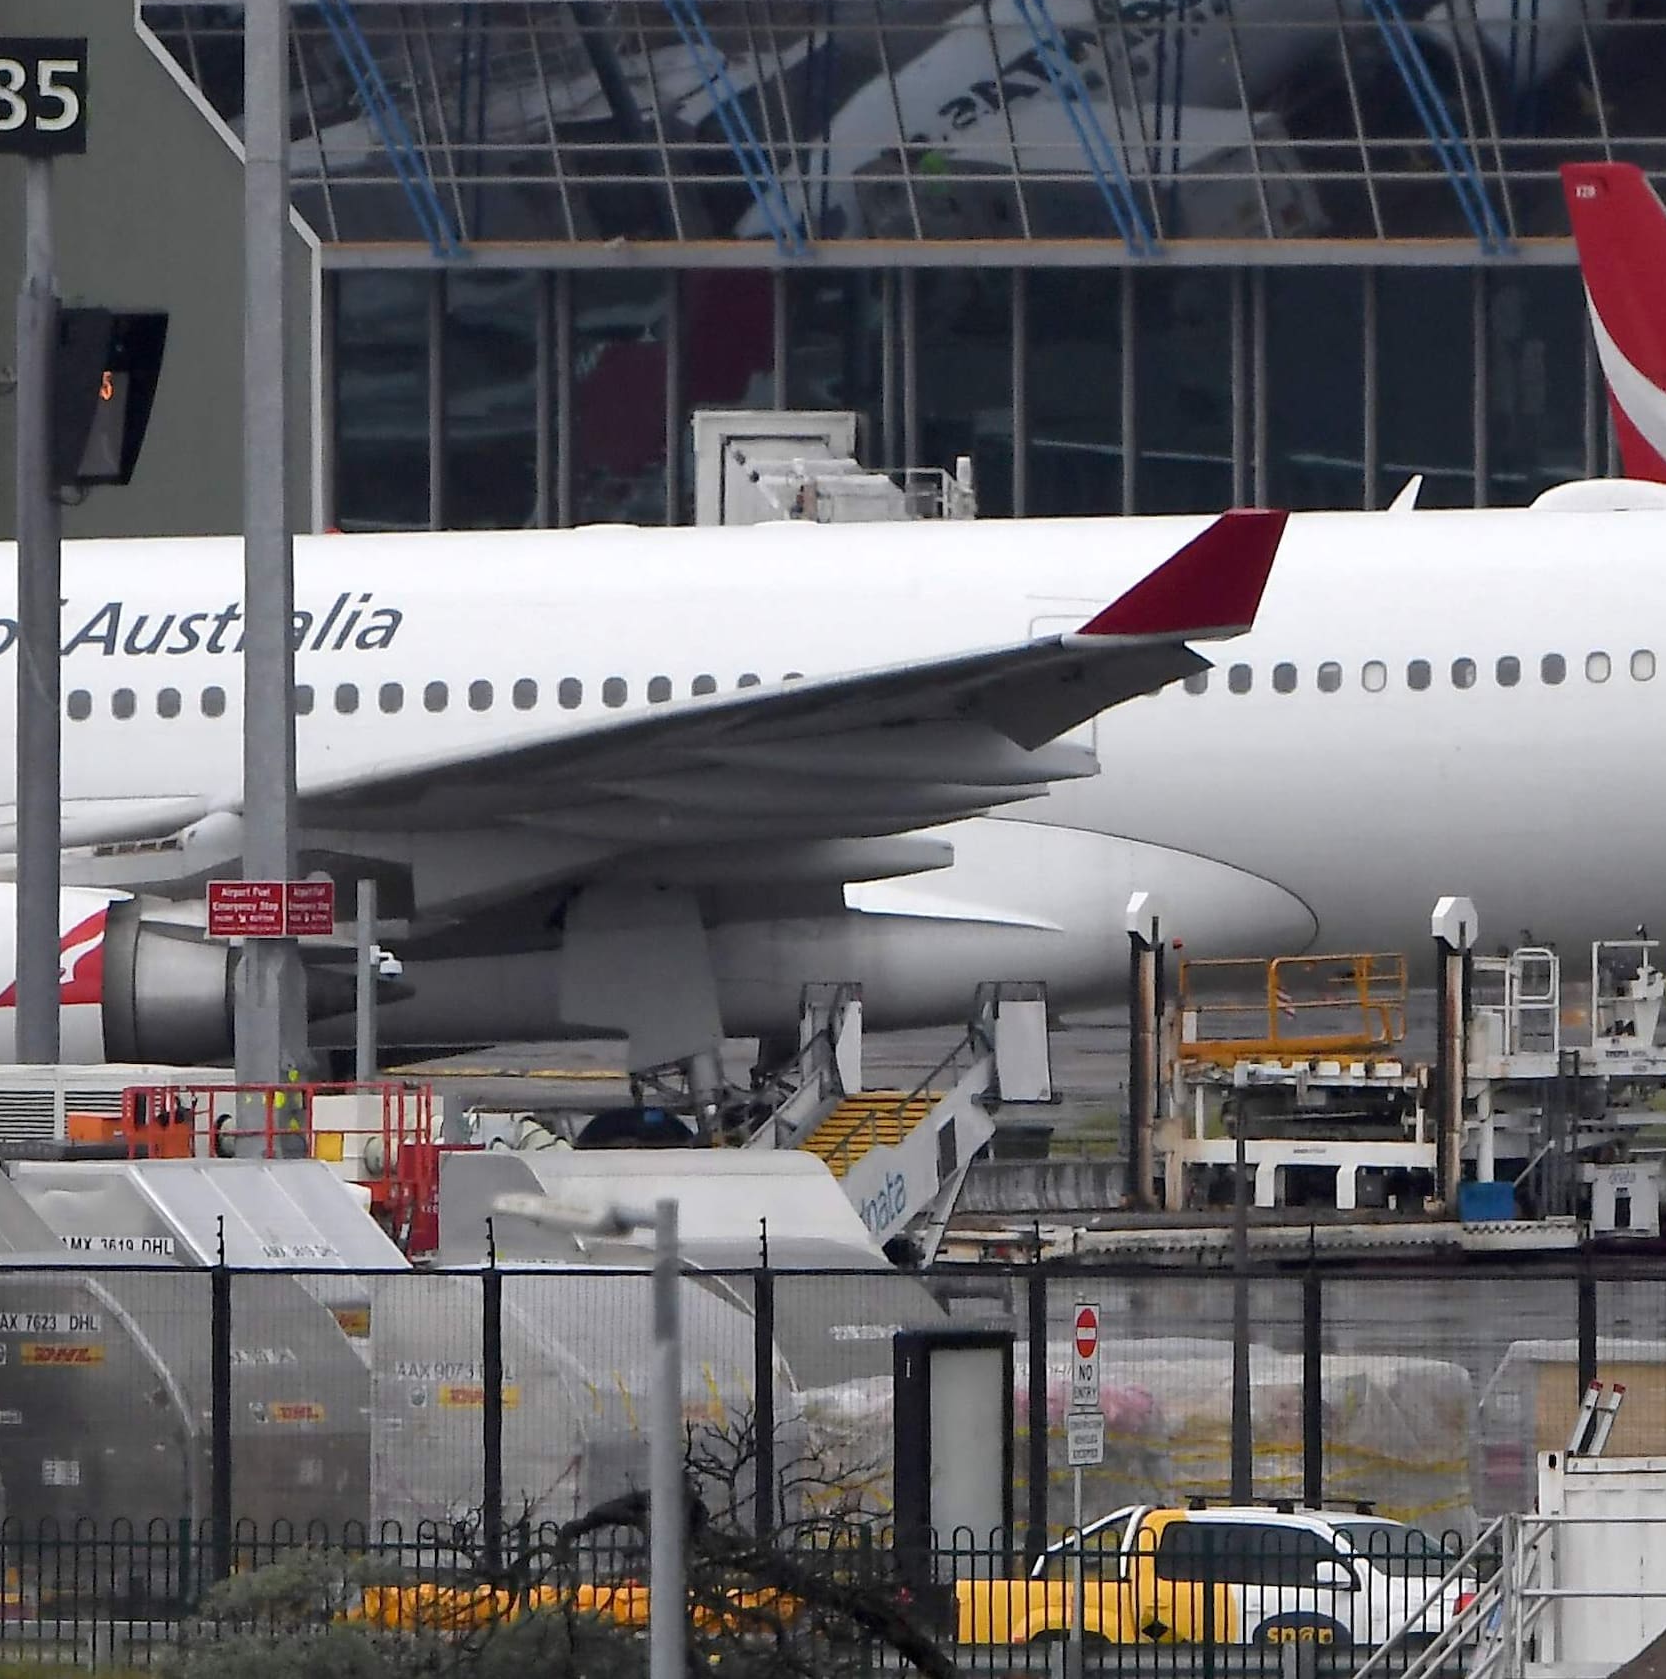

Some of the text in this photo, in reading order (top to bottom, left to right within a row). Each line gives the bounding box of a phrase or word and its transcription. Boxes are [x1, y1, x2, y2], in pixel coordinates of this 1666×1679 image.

[141, 1239, 173, 1255] DHL
[26, 1315, 57, 1331] 7623
[69, 1315, 97, 1331] DHL
[34, 1347, 91, 1362] DHL
[1079, 1365, 1093, 1381] NO
[1074, 1386, 1096, 1399] ENTRY
